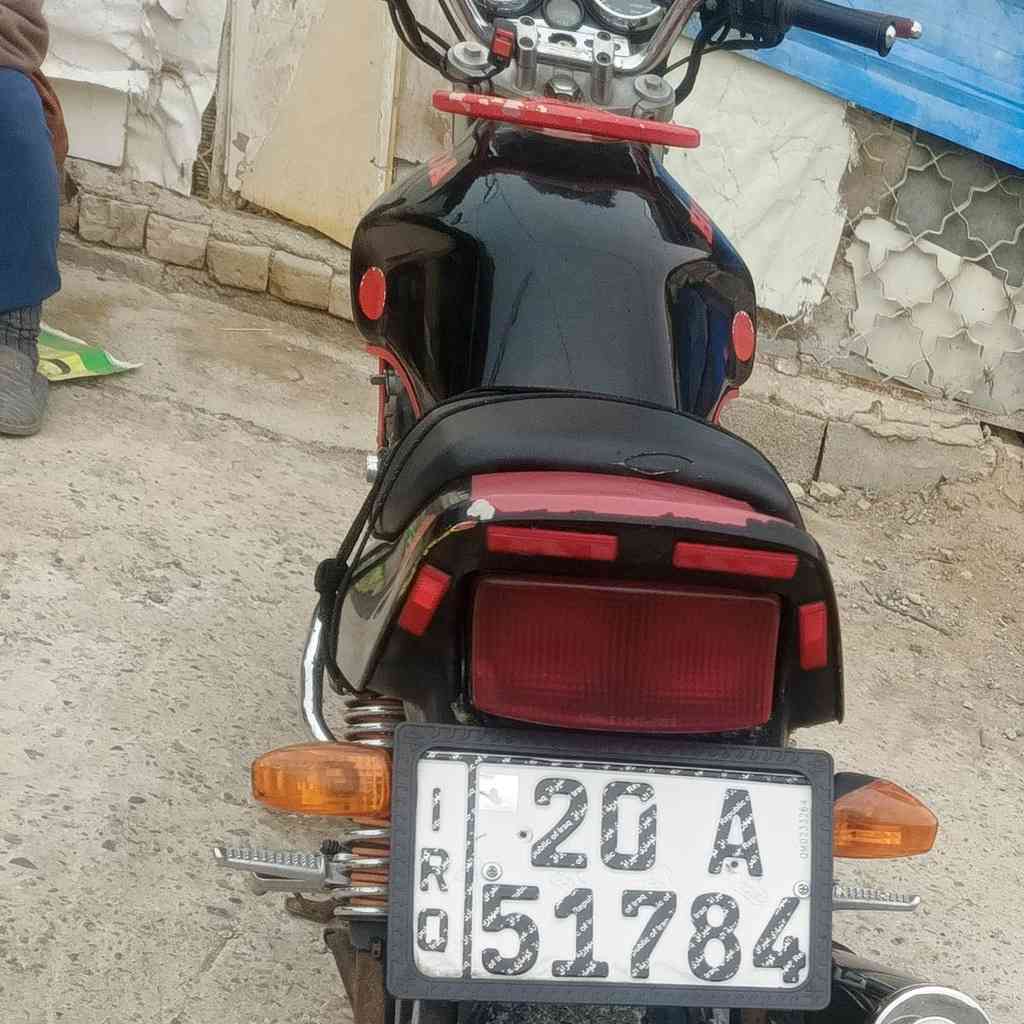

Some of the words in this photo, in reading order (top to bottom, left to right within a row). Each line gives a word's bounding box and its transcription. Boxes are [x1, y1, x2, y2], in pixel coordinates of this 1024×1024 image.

[417, 787, 449, 952] IRQ
[531, 778, 657, 871] 20
[708, 788, 763, 877] A
[481, 883, 807, 984] 51784
